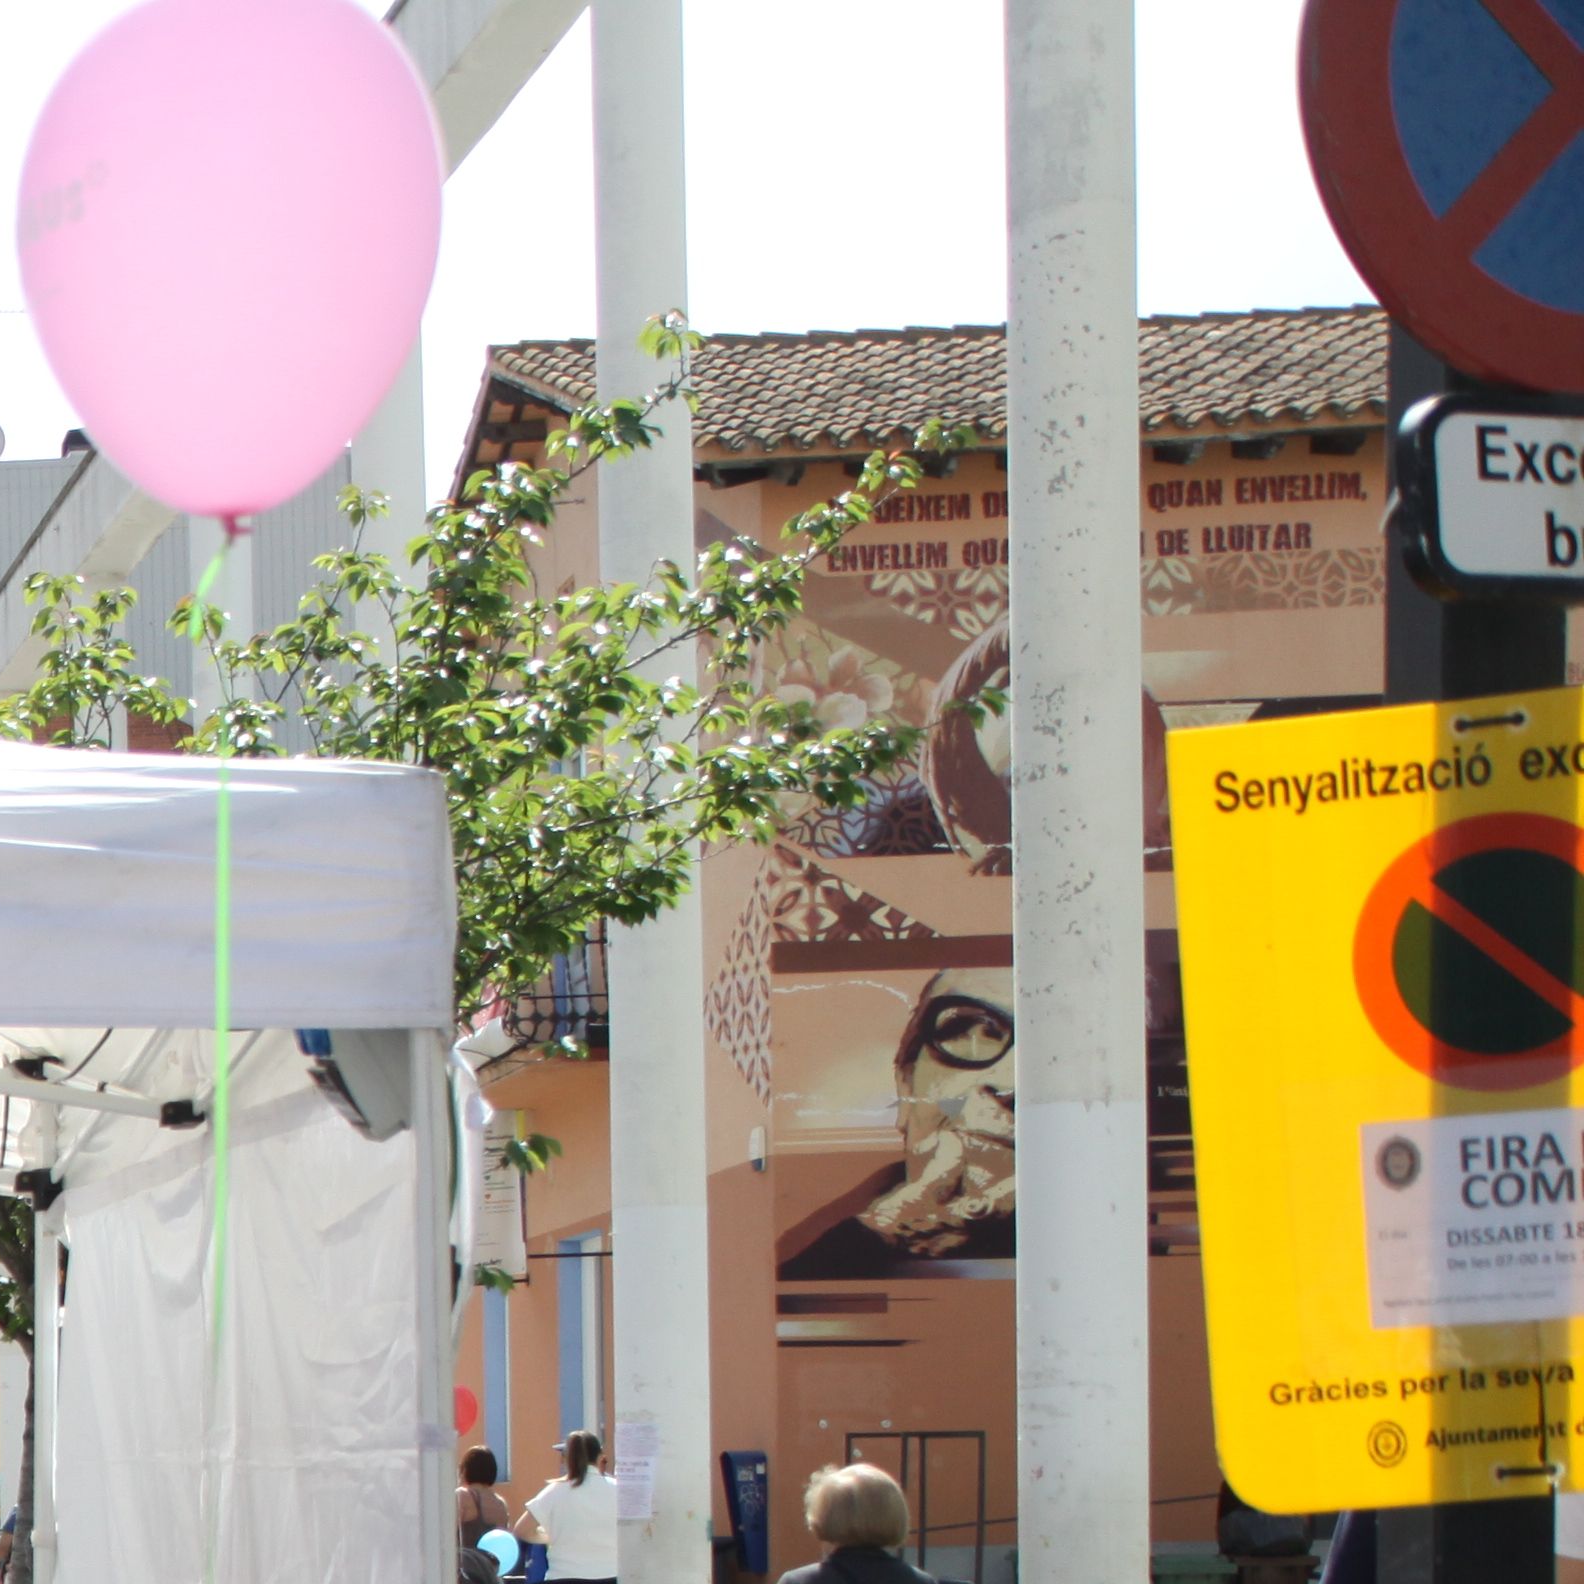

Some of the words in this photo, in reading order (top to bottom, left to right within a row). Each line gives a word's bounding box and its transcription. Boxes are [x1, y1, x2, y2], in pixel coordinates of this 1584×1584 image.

[1476, 424, 1584, 485] Exc
[875, 493, 970, 524] DEIXEM
[1147, 478, 1223, 512] QUAN
[1235, 471, 1366, 504] ENVELLIM,
[827, 541, 948, 573] ENVELLIM
[1156, 529, 1189, 557] DE
[1202, 522, 1311, 554] LLUITAR
[1214, 742, 1491, 815] Senyalització
[1459, 1133, 1565, 1173] FIRA
[1460, 1168, 1584, 1210] COM
[1446, 1223, 1554, 1248] DISSABTE
[1269, 1378, 1388, 1405] Gràcies
[1400, 1373, 1448, 1400] per
[1459, 1367, 1486, 1390] la
